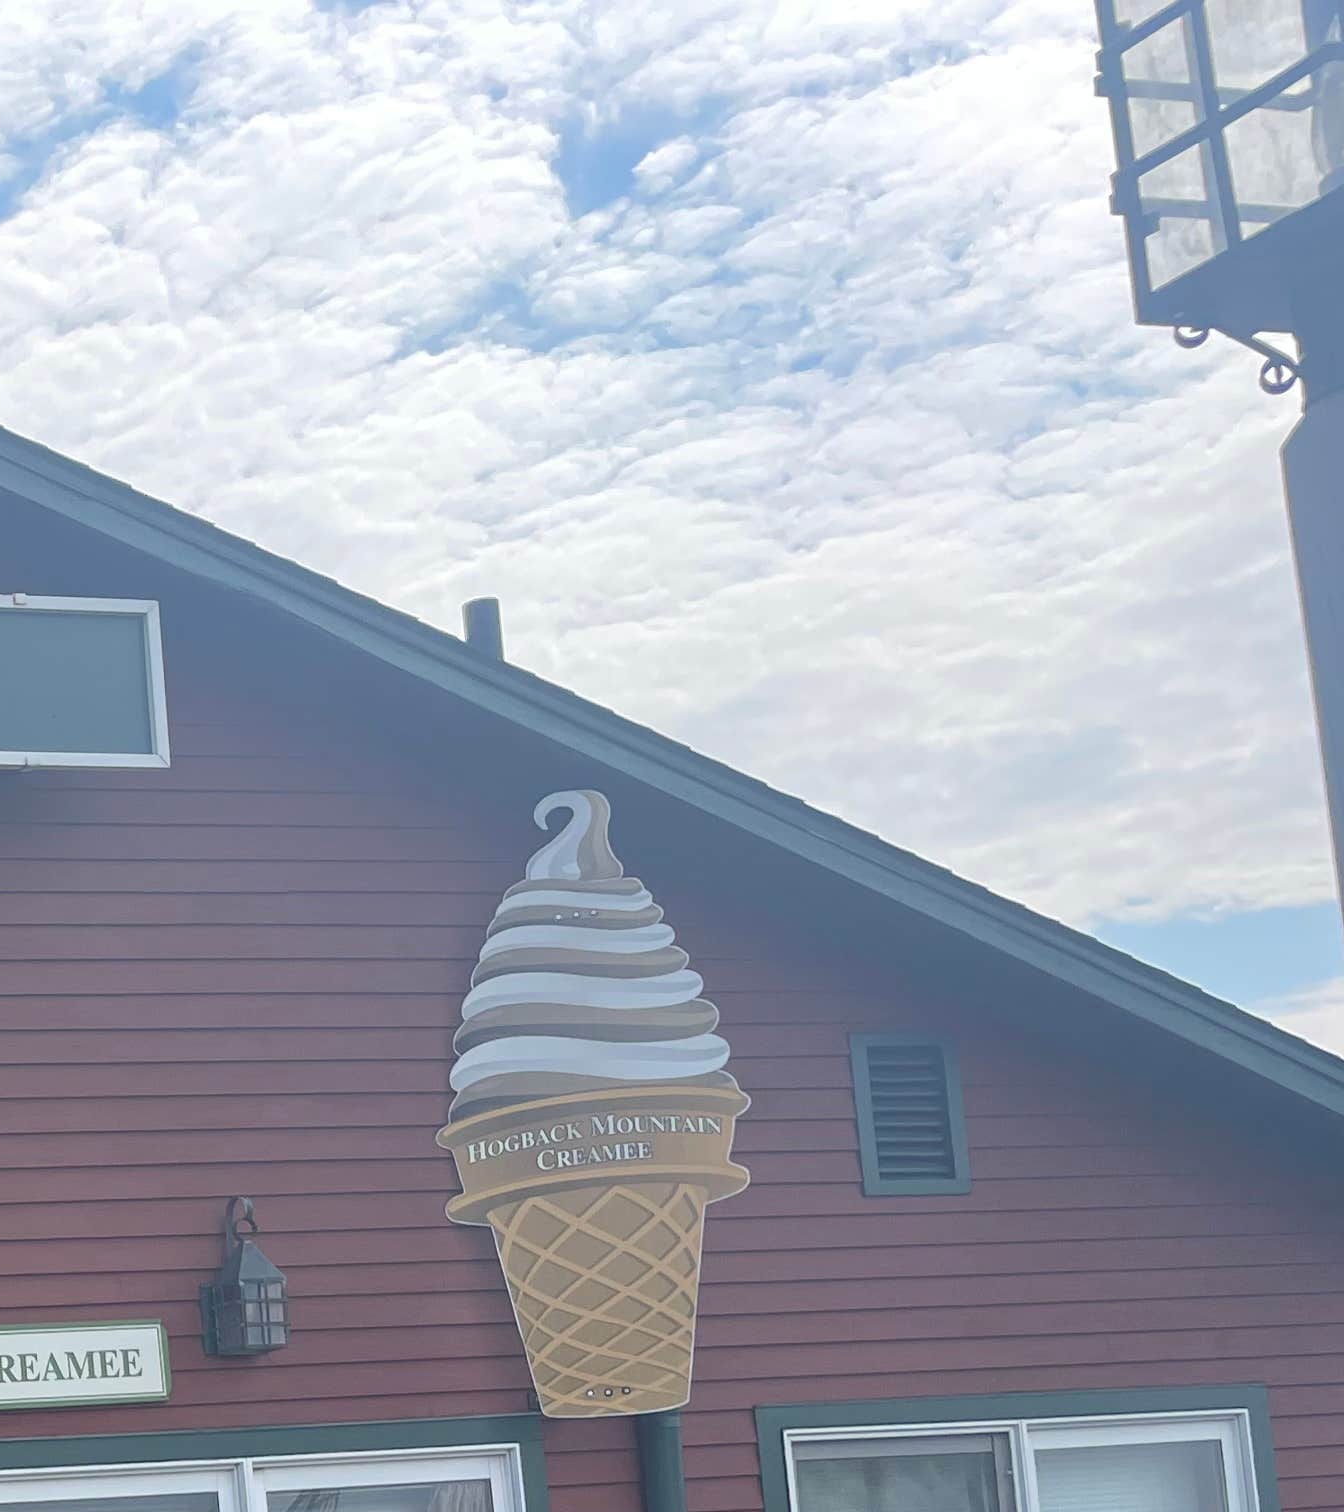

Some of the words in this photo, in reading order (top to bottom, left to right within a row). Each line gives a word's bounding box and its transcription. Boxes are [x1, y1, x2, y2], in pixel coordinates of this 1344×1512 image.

[465, 1123, 583, 1165] HOGBACK
[590, 1113, 724, 1136] MOUNTAIN
[535, 1141, 653, 1171] CREAMEE
